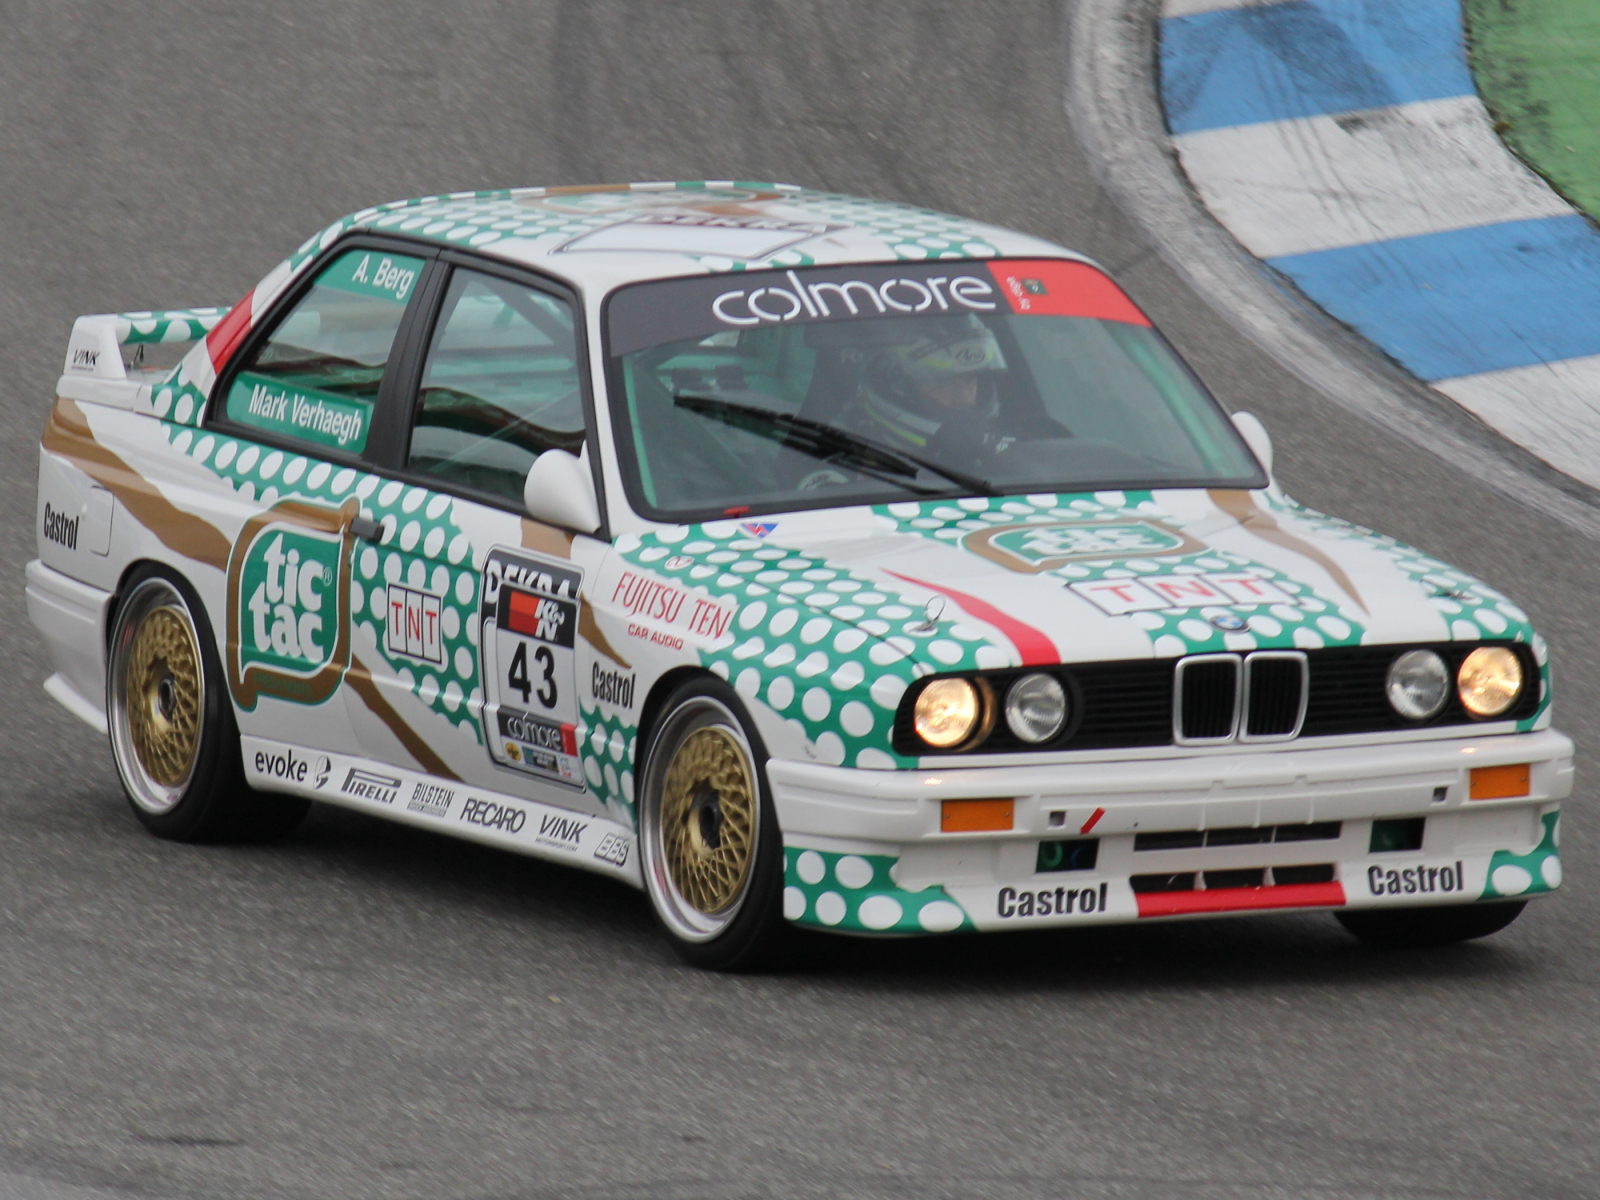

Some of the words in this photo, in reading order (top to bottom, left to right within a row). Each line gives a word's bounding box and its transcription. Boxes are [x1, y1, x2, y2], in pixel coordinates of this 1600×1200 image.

[352, 253, 369, 283] A.
[372, 258, 415, 300] Berg
[712, 270, 997, 325] colmore
[73, 349, 100, 366] VINK
[248, 383, 288, 421] Mark
[291, 393, 362, 446] Verhaegh
[44, 501, 79, 551] Castrol
[263, 532, 324, 612] tic
[1089, 577, 1265, 603] TNT
[248, 581, 324, 663] tac
[391, 601, 437, 645] TNT
[611, 571, 687, 623] FUJITSU
[688, 598, 734, 640] TEN
[628, 623, 649, 641] CAR
[650, 633, 685, 650] AUDIO
[508, 641, 558, 709] 43
[592, 660, 636, 709] Castrol
[507, 711, 562, 751] colmore
[255, 749, 308, 782] evoke
[341, 767, 402, 804] PIRELLI
[411, 782, 455, 808] BILSTEIN
[460, 796, 527, 834] RECARO
[539, 813, 589, 844] VINK
[1366, 862, 1464, 896] Castrol
[996, 881, 1109, 919] Castrol
